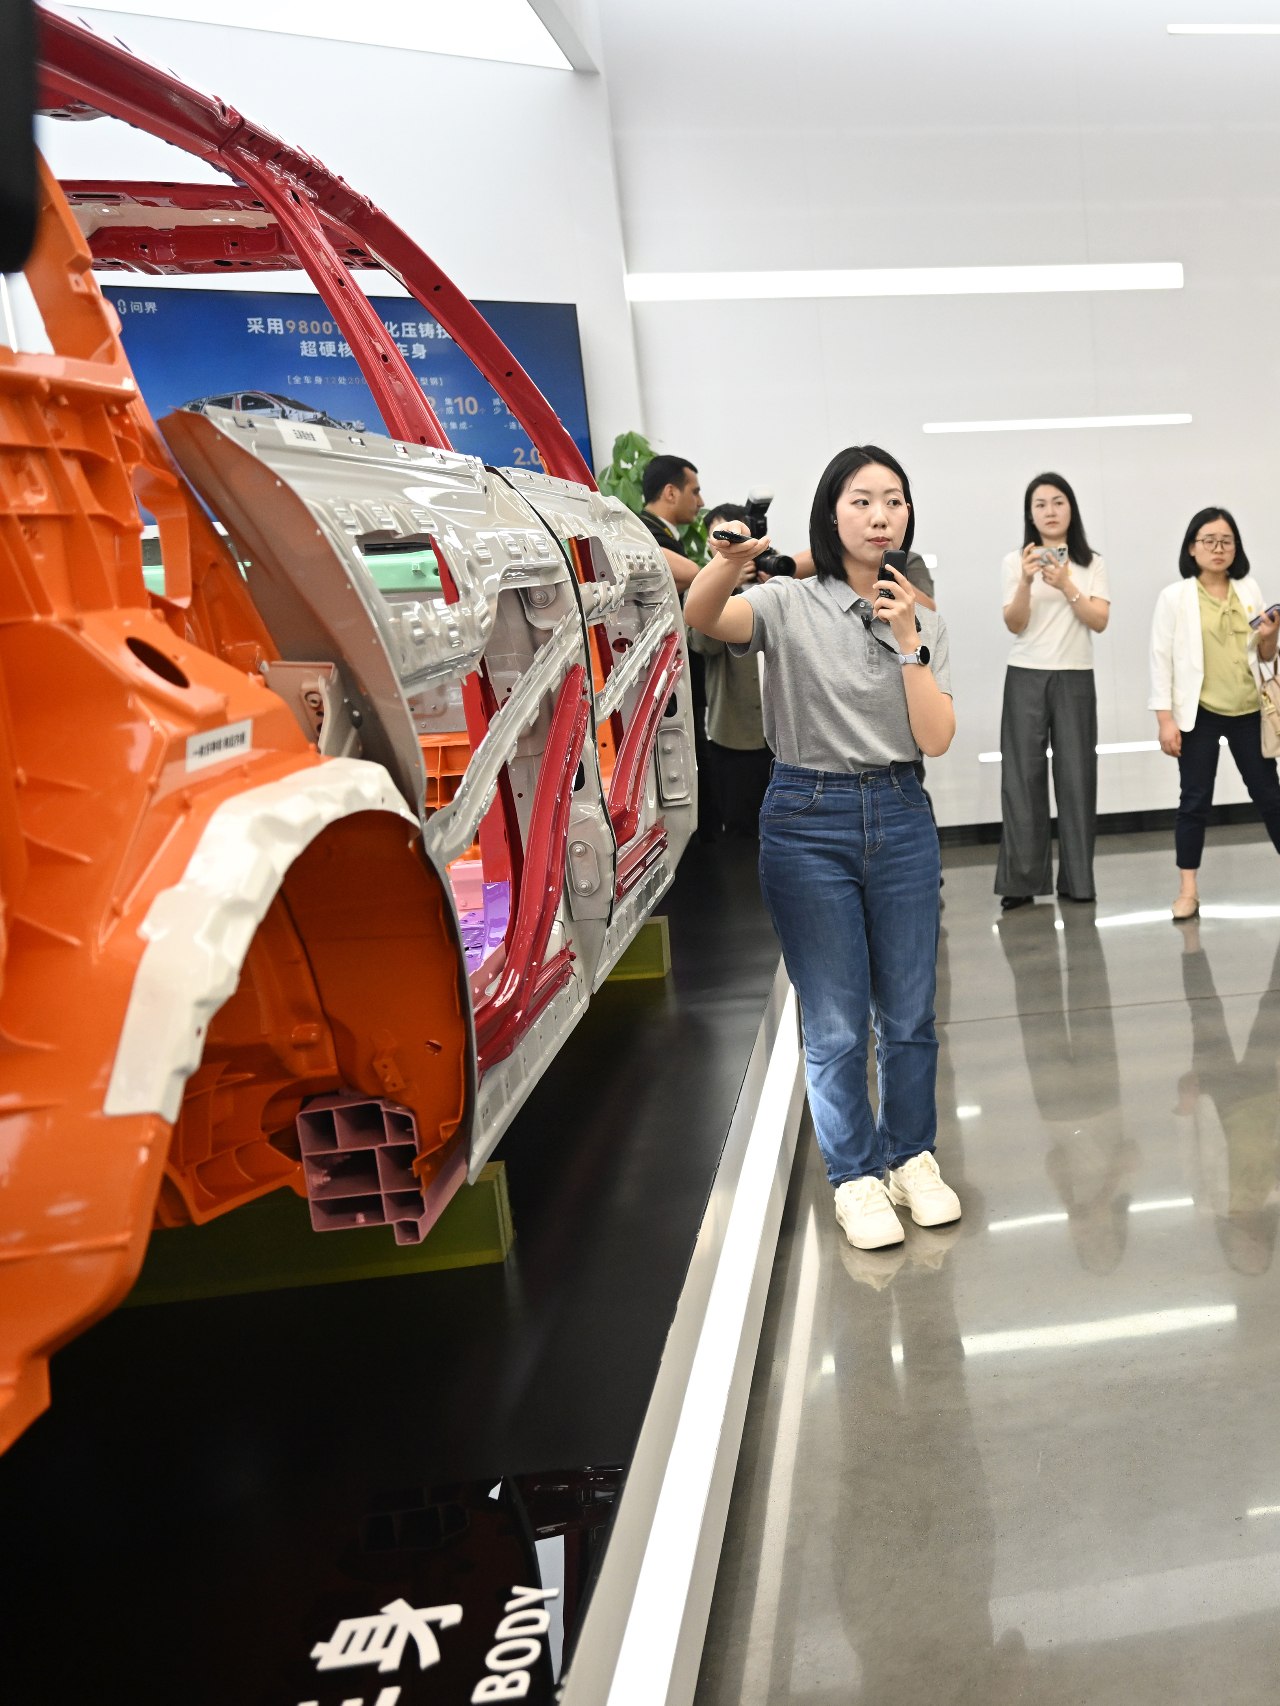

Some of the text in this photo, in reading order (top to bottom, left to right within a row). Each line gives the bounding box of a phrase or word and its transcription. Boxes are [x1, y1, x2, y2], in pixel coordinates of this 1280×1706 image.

[130, 301, 158, 315] 问界
[454, 396, 479, 416] 10
[470, 1585, 560, 1704] BODY
